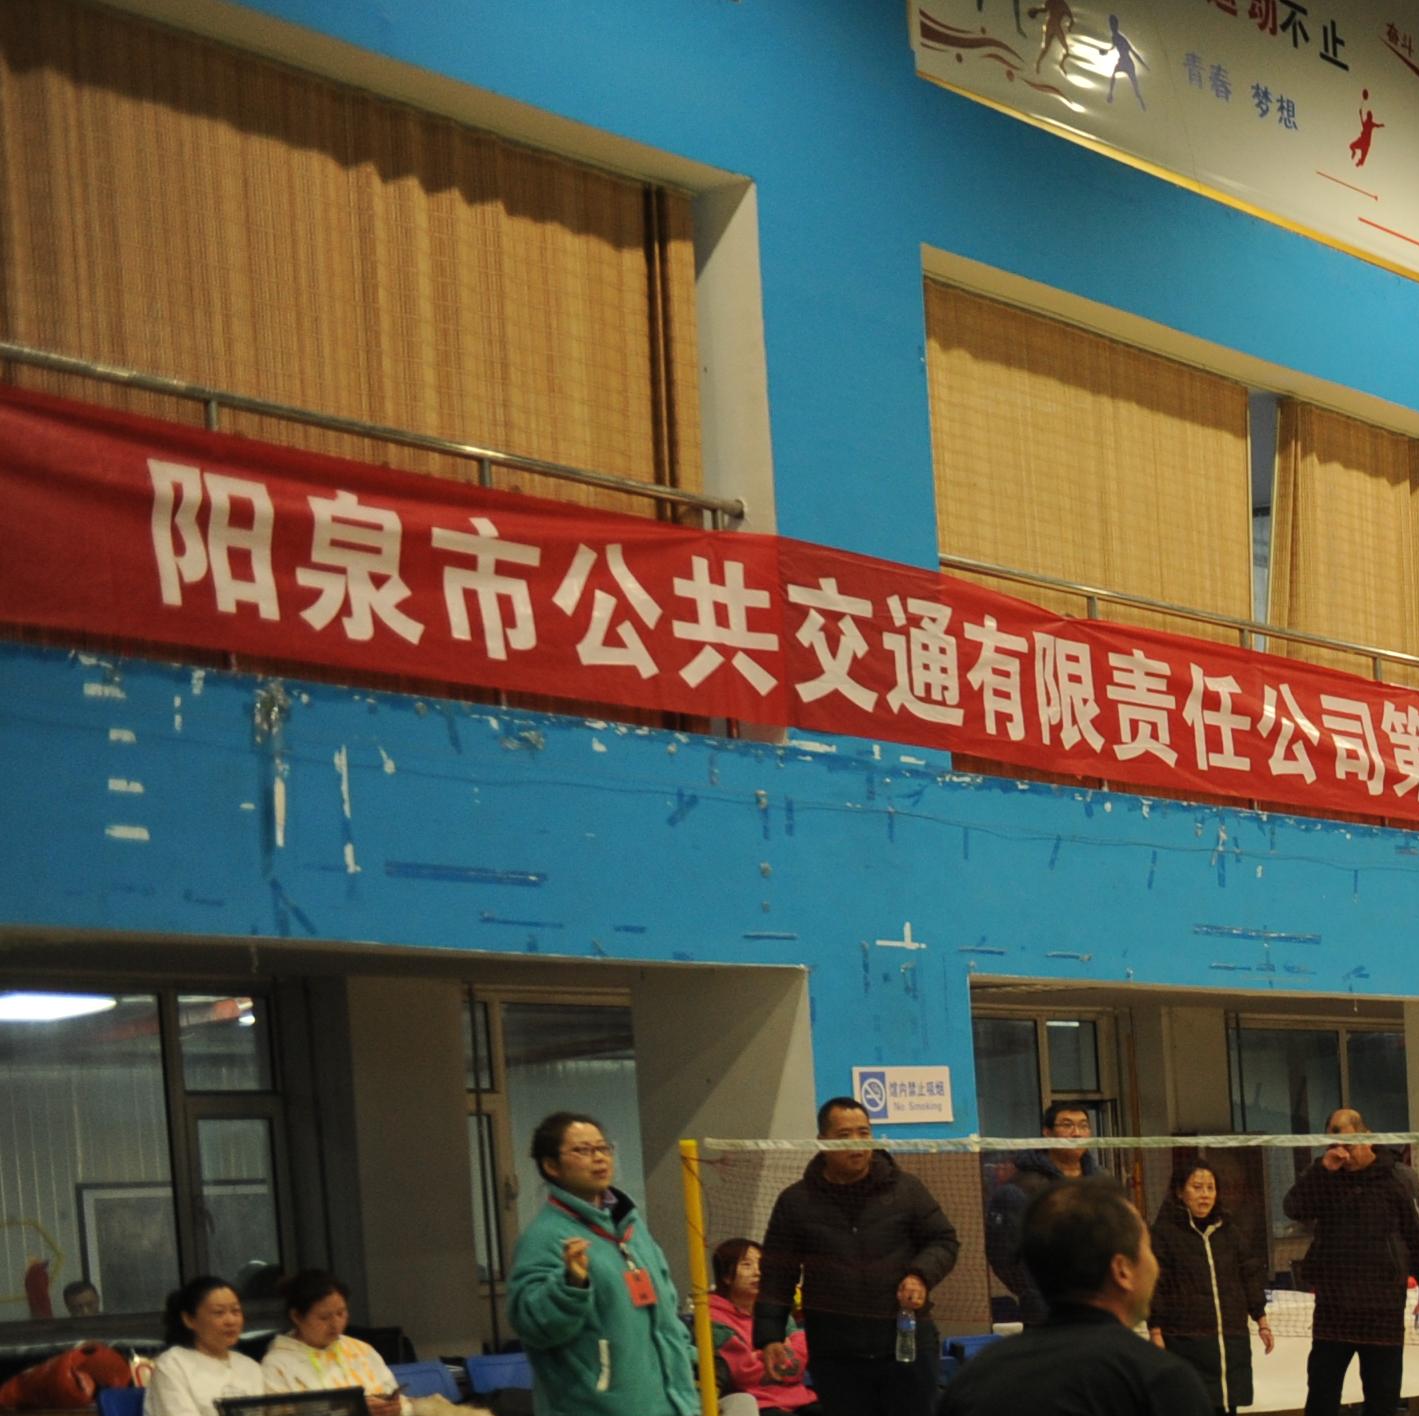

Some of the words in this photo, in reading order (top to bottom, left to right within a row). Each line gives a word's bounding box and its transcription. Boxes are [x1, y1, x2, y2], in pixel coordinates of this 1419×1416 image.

[1182, 51, 1233, 103] 青春
[1250, 82, 1299, 132] 梦想
[894, 1102, 906, 1111] No
[908, 1101, 943, 1113] Smoking
